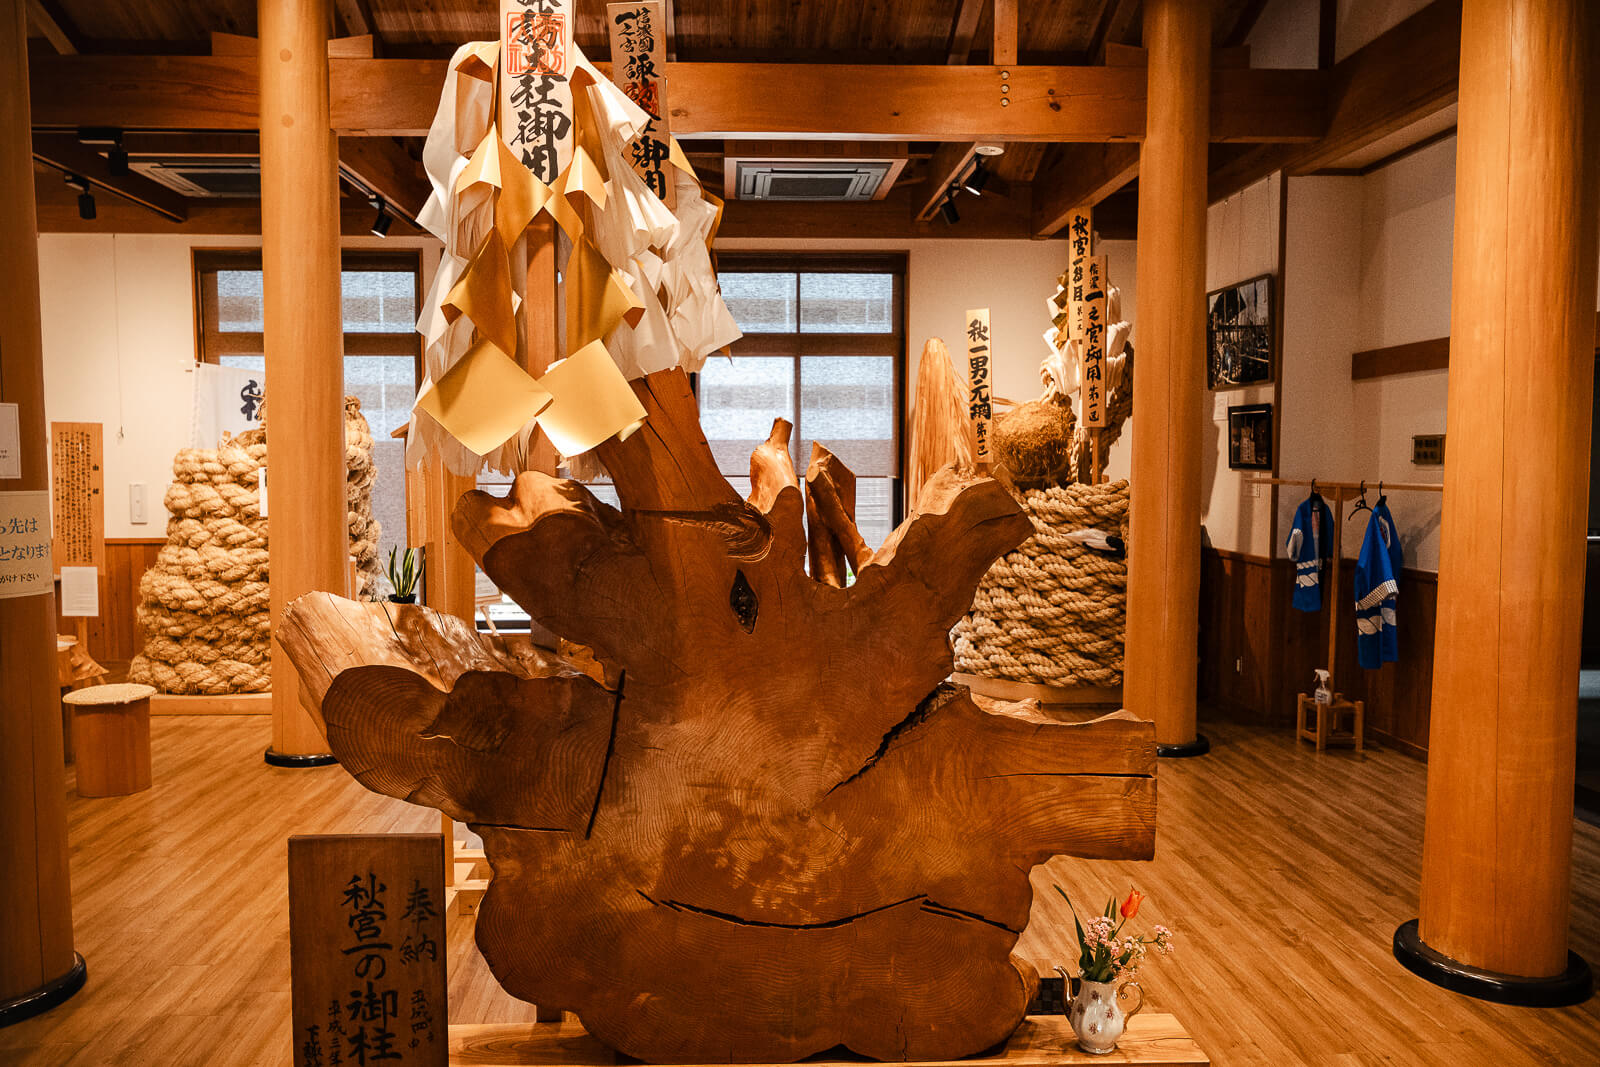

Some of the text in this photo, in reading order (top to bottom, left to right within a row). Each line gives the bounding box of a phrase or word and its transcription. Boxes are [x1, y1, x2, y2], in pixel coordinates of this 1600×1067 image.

[509, 0, 571, 186] 訪大社御用
[341, 872, 402, 1067] 秋宮一の御柱
